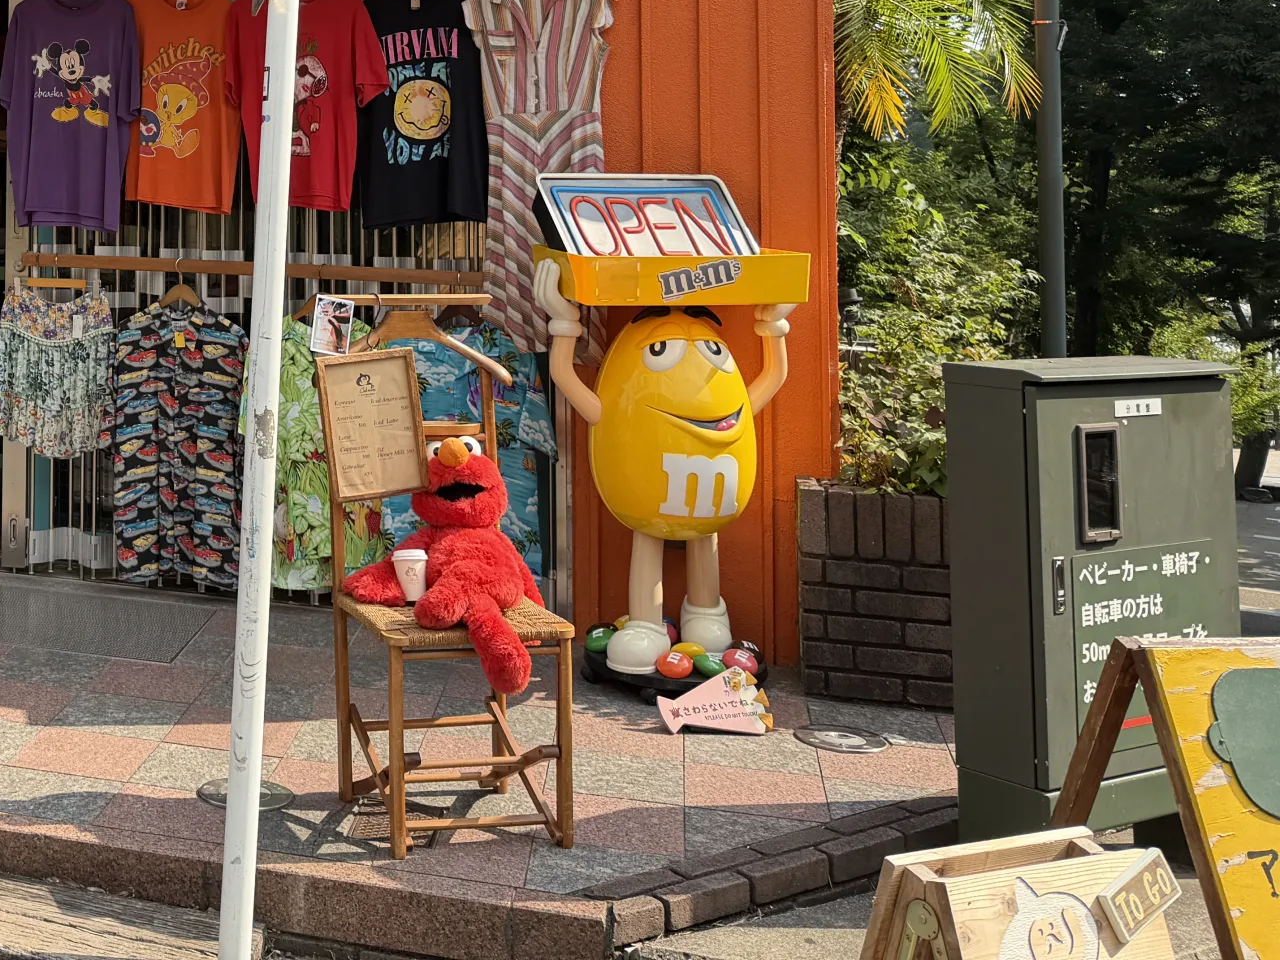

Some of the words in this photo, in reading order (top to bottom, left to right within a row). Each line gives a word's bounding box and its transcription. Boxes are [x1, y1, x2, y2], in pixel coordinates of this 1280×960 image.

[142, 37, 226, 88] ewitched
[384, 61, 426, 97] OME
[33, 86, 64, 99] ebraska
[382, 127, 426, 166] YOU
[570, 196, 734, 257] OPEN
[659, 259, 742, 298] m&m's
[658, 453, 739, 518] m
[1081, 593, 1163, 627] 自転車の方は
